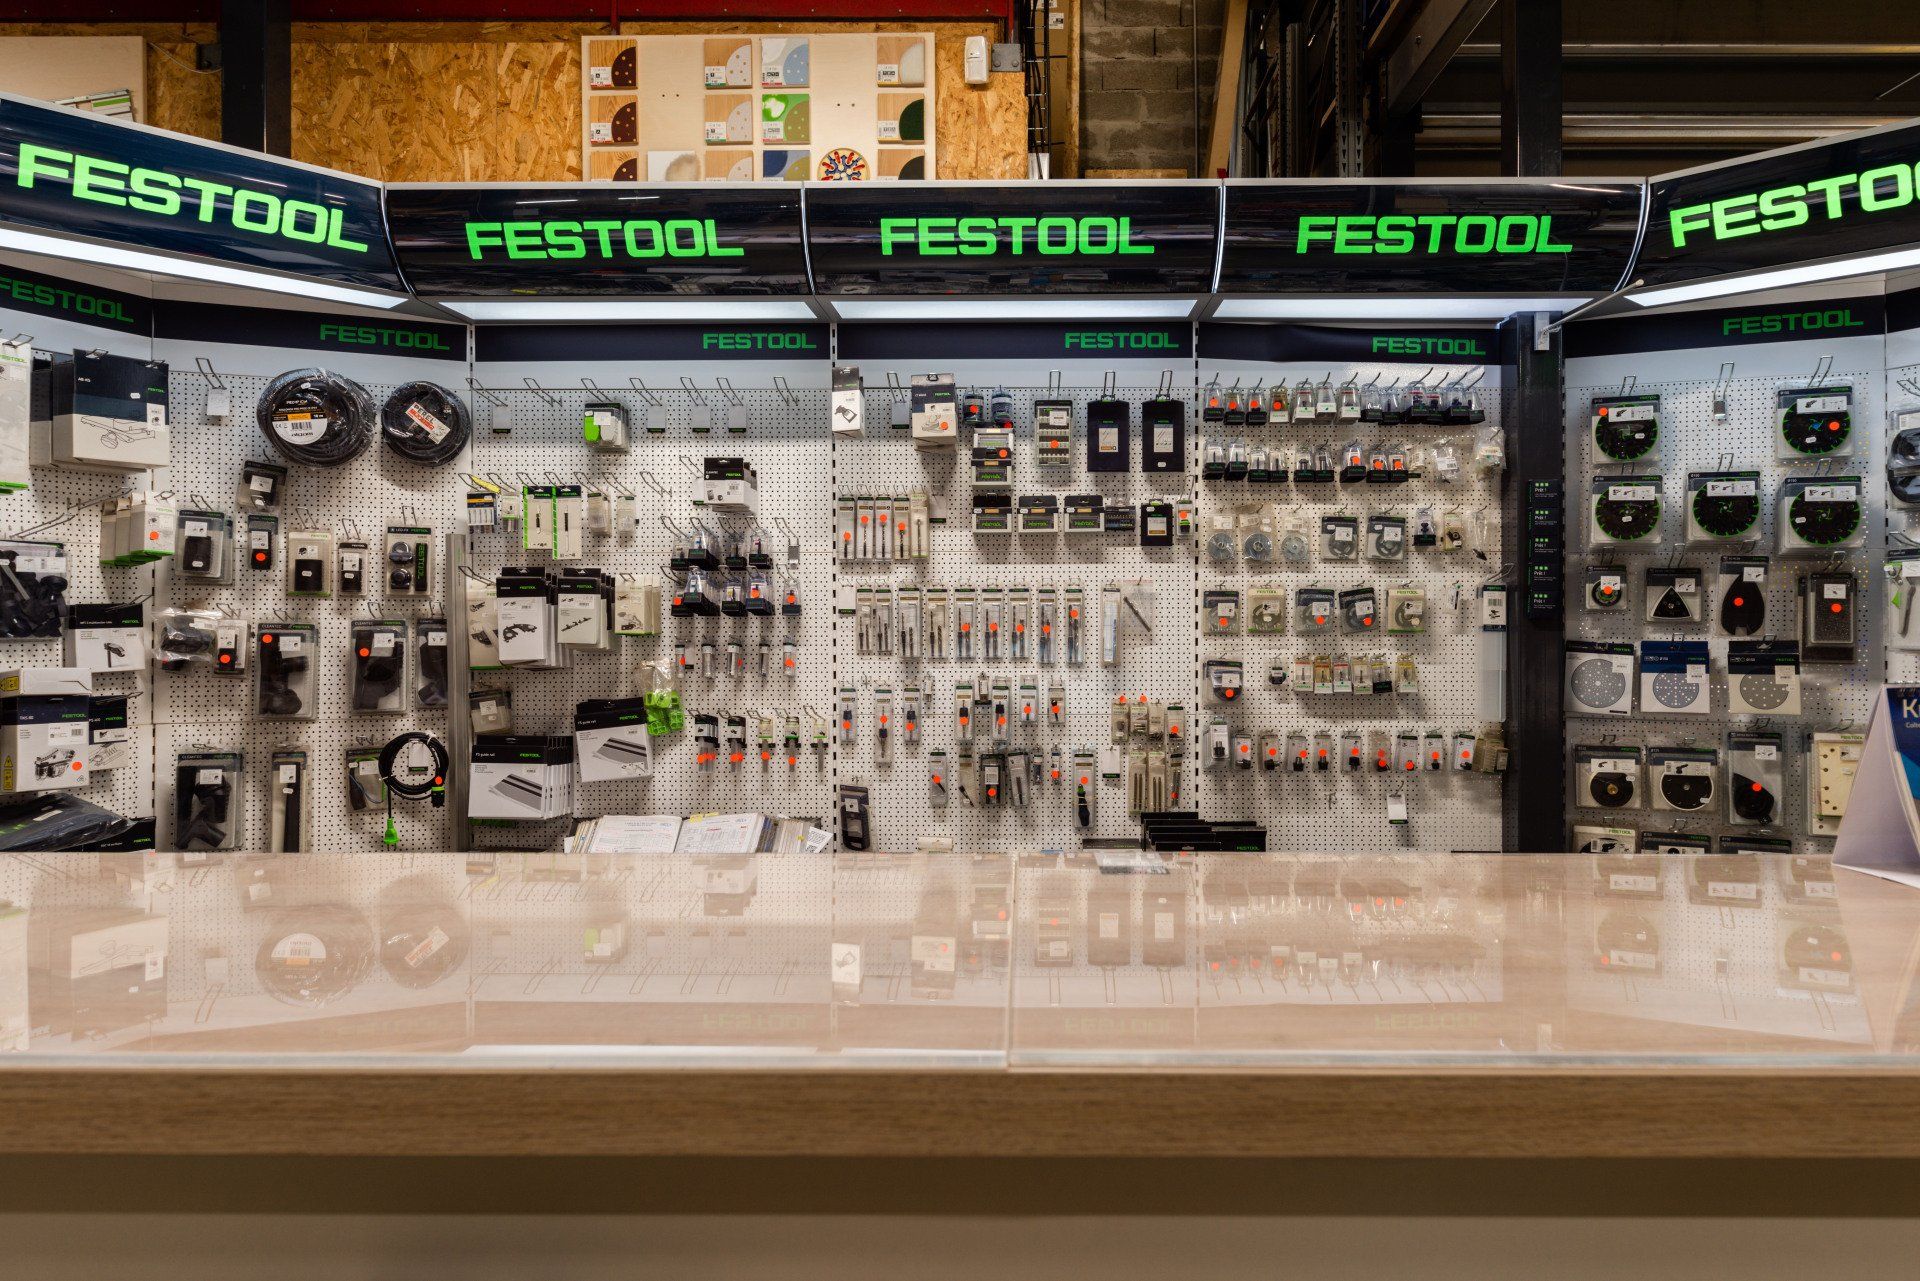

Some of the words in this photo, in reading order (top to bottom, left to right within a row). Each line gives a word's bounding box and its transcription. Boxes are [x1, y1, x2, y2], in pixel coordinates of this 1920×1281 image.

[17, 143, 369, 254] FESTOOL
[1669, 159, 1920, 249] FESTO
[466, 219, 745, 259] FESTOOL
[880, 217, 1156, 256] FESTOOL
[1297, 215, 1573, 254] FESTOOL
[1723, 309, 1864, 336] FESTOOL
[320, 324, 450, 350] FESTOOL
[702, 332, 817, 350] FESTOOL
[1064, 331, 1179, 349] FESTOOL
[1372, 336, 1486, 356] FESTOOL
[1903, 698, 1920, 718] K
